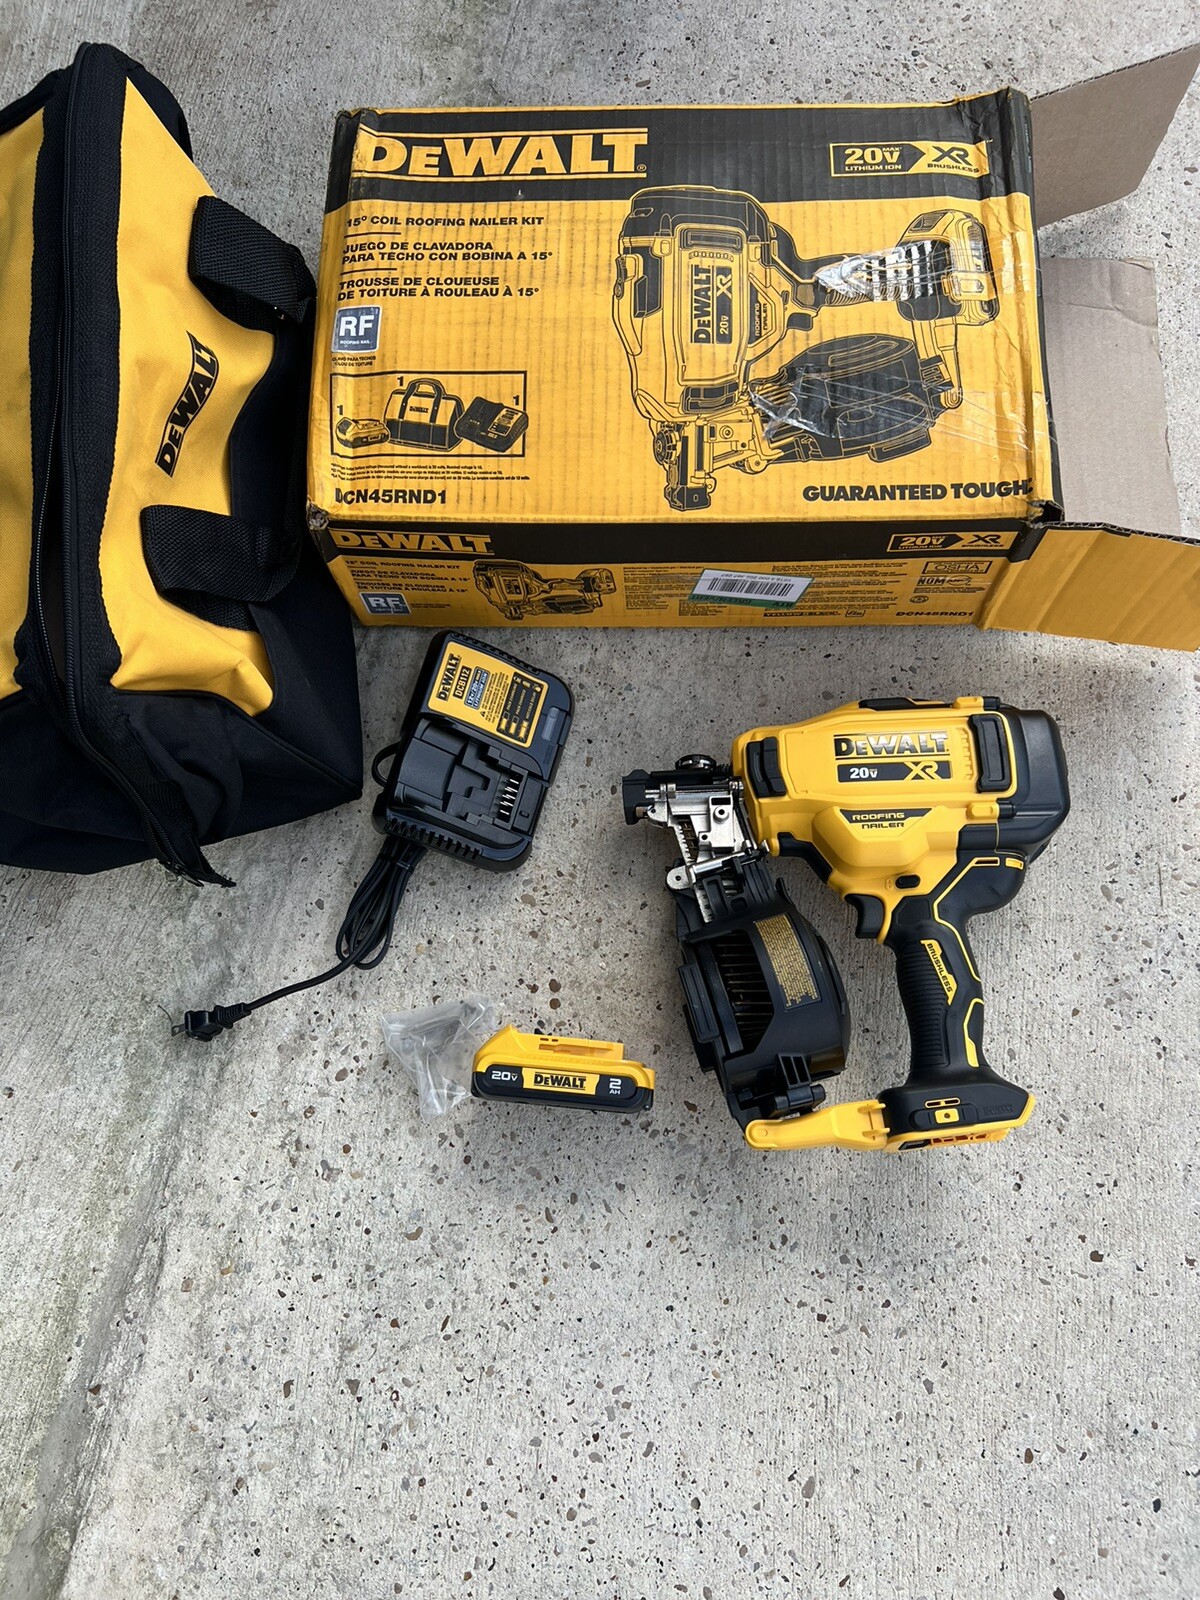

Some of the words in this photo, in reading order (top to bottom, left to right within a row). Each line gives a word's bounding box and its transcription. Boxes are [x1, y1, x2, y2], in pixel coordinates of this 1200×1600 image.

[352, 129, 648, 176] DEWALT
[844, 148, 900, 164] 20V
[932, 146, 973, 166] XR
[927, 163, 980, 173] BRUSHLESS
[370, 216, 402, 225] COIL
[405, 218, 465, 226] ROOFING
[469, 217, 518, 226] NAILER
[522, 216, 544, 225] KIT
[343, 242, 386, 254] JUEGO
[390, 242, 409, 250] DE
[413, 242, 494, 250] CLAVADORA
[342, 252, 375, 265] PARA
[379, 252, 424, 260] TECHO
[428, 252, 458, 260] CON
[462, 252, 514, 260] BOBINA
[516, 252, 526, 260] A
[339, 277, 400, 290] TROUSSE
[403, 277, 422, 286] DE
[426, 277, 500, 286] CLOUEUSE
[716, 274, 732, 299] XR
[338, 290, 354, 301] DE
[360, 288, 417, 298] TOITURE
[420, 286, 430, 296] À
[434, 288, 500, 297] ROULEAU
[502, 285, 512, 296] À
[694, 264, 712, 344] DEWALT
[339, 315, 374, 336] RF
[720, 315, 729, 334] 20V
[397, 376, 404, 386] 1
[512, 395, 520, 406] 1
[336, 405, 344, 416] 1
[335, 488, 446, 505] DCN45RND1
[802, 483, 948, 501] GUARANTEED
[330, 530, 492, 553] DEWALT
[968, 534, 1002, 544] XR
[368, 597, 401, 608] RF
[437, 653, 462, 701] DEWALT
[455, 668, 470, 696] DCB112
[834, 733, 948, 756] DEWALT
[850, 767, 878, 779] 20V
[904, 761, 943, 780] XR
[852, 812, 905, 821] ROOFING
[927, 943, 953, 993] BRUSHLESS
[534, 1073, 586, 1089] DEWALT
[609, 1078, 622, 1089] 2
